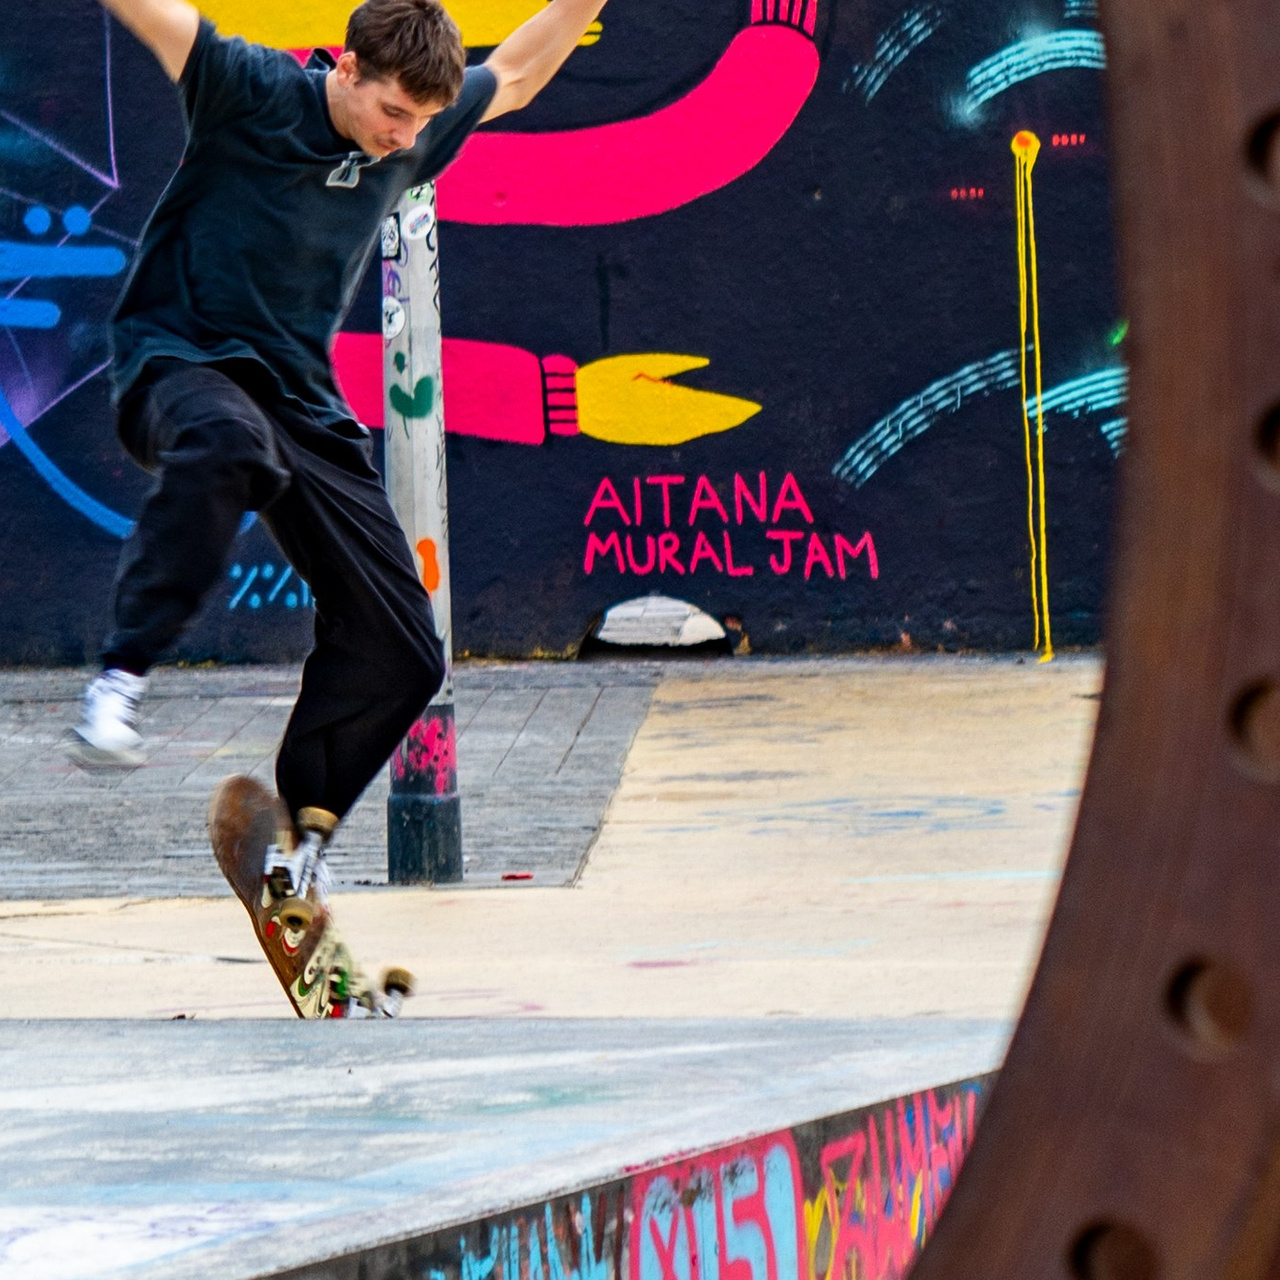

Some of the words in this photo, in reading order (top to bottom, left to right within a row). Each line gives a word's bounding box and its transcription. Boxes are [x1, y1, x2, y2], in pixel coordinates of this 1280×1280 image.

[583, 471, 815, 527] AITANA
[583, 530, 754, 576] MURAL
[765, 530, 880, 580] JAM
